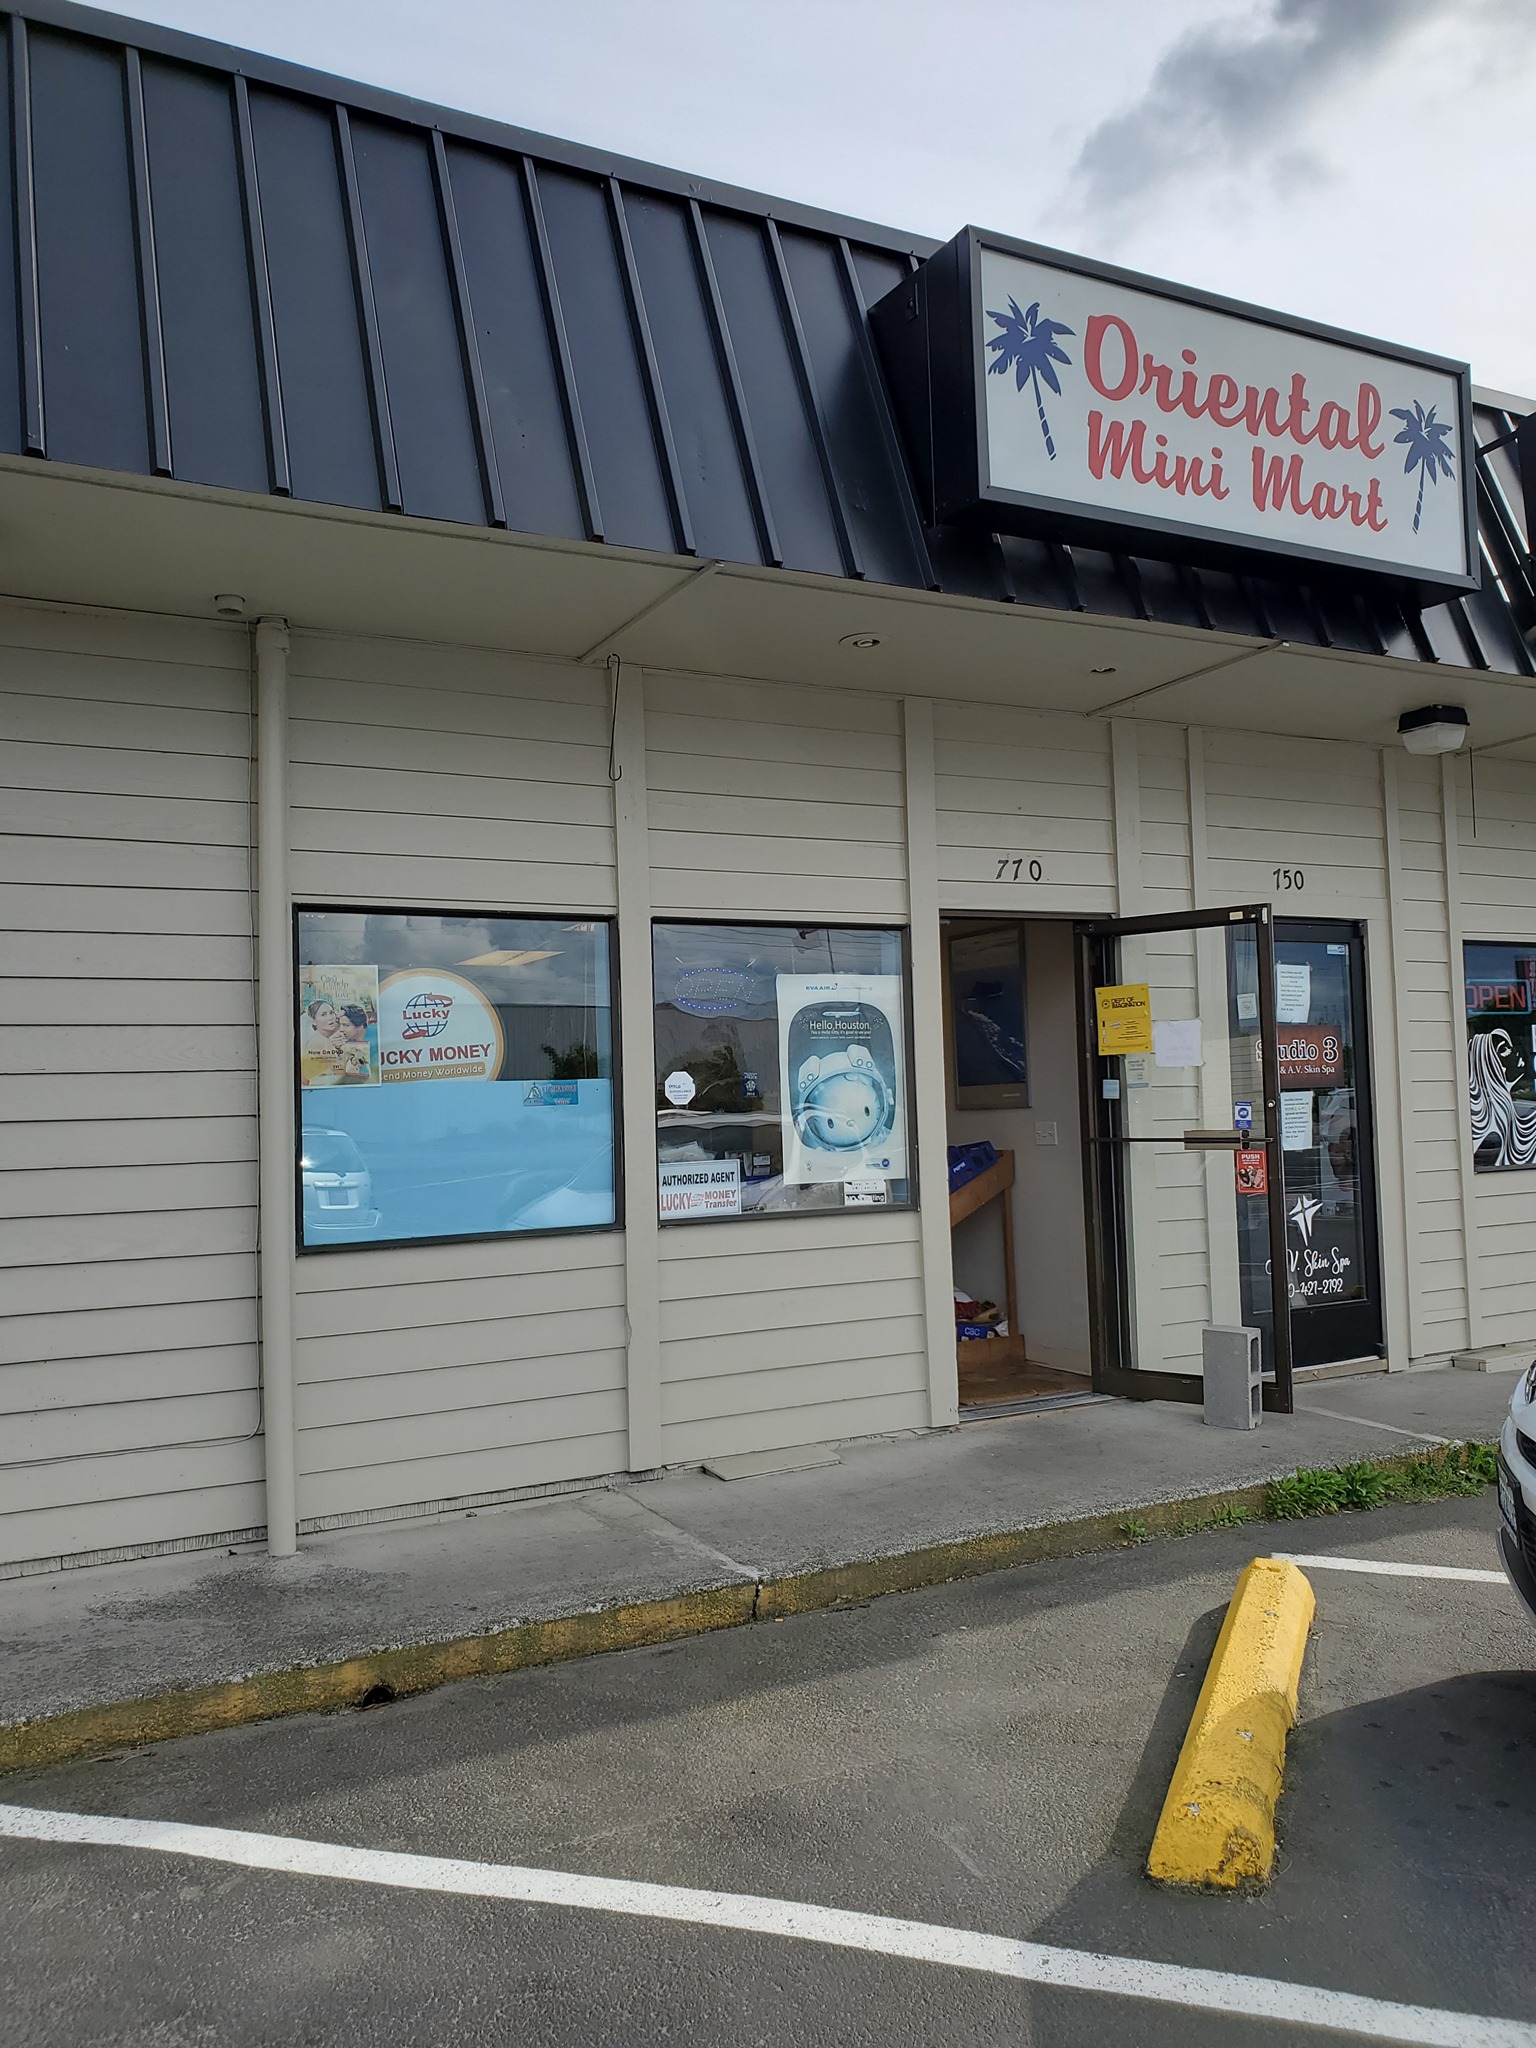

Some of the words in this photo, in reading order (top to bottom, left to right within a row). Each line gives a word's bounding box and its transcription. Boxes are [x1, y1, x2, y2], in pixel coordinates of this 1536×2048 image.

[1084, 314, 1385, 460] Oriental
[1087, 410, 1230, 500] Mini
[1251, 446, 1389, 532] Mart
[995, 858, 1042, 882] 770
[675, 978, 756, 1001] OPEN
[402, 1008, 450, 1020] Lucky
[380, 1048, 423, 1066] CKY
[428, 1043, 492, 1062] MONEY
[1255, 1039, 1319, 1062] udio
[1322, 1036, 1338, 1063] 3
[381, 1072, 400, 1081] end
[402, 1069, 433, 1080] Money
[434, 1065, 483, 1077] Worldwide
[1280, 1065, 1287, 1074] &
[1287, 1065, 1303, 1074] A.V.
[1304, 1064, 1320, 1073] Skin
[1321, 1064, 1335, 1074] Spa
[661, 1173, 709, 1186] AUTHORIZED
[710, 1171, 736, 1182] AGENT
[660, 1192, 693, 1212] LUCKY
[704, 1189, 737, 1201] MONEY
[704, 1200, 738, 1209] Transfer
[1303, 1249, 1331, 1278] Skin
[1331, 1246, 1352, 1275] Spa
